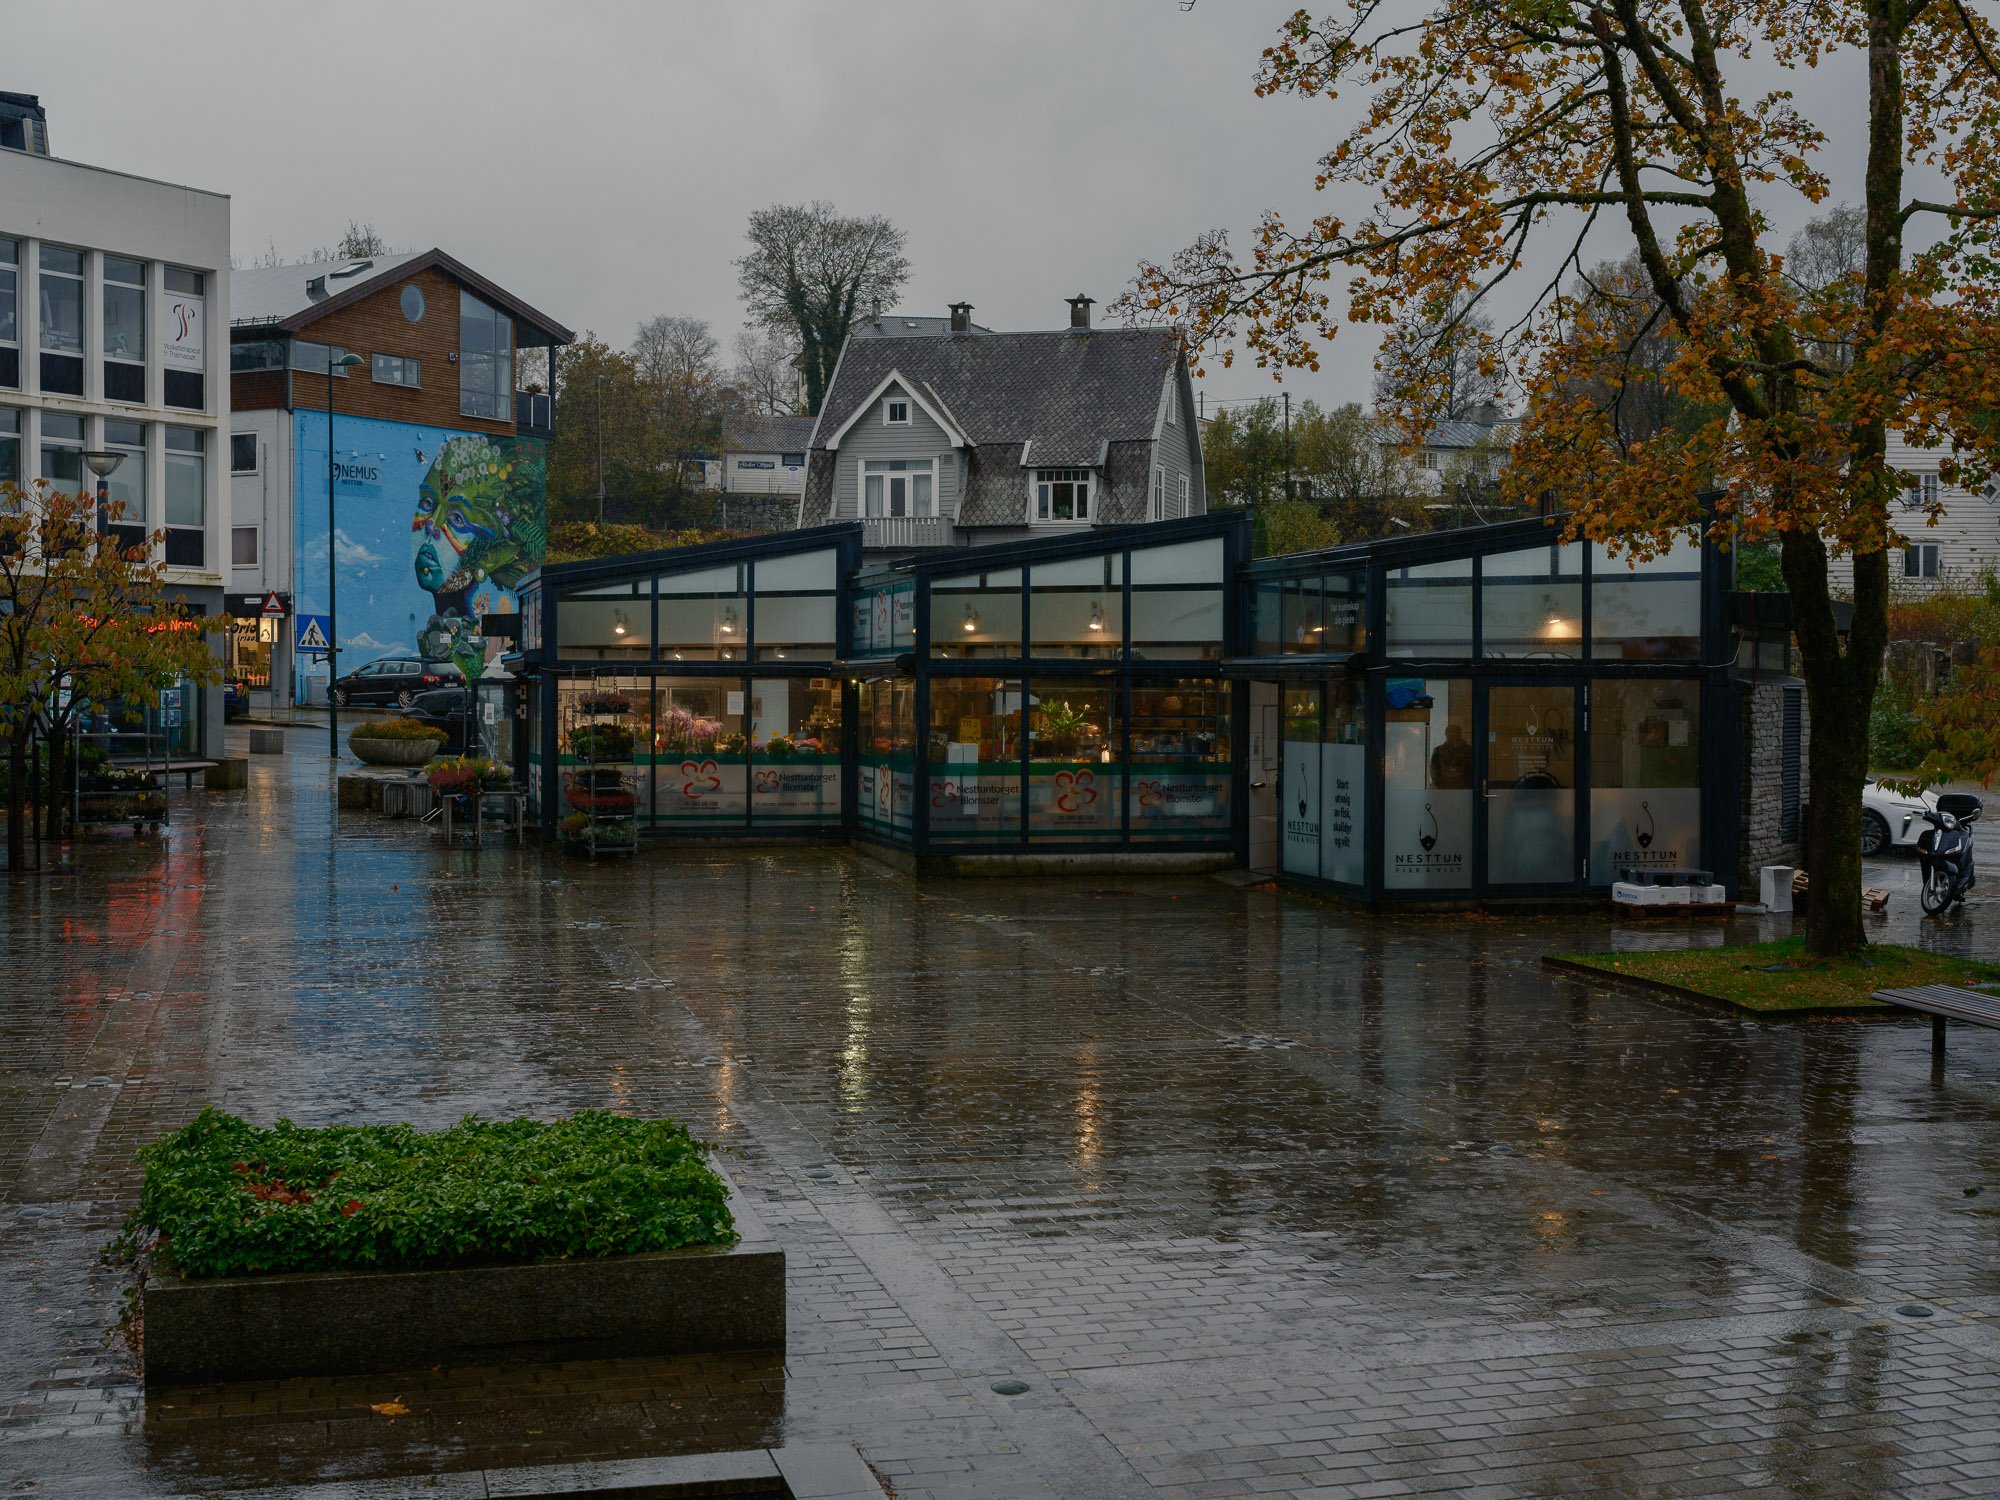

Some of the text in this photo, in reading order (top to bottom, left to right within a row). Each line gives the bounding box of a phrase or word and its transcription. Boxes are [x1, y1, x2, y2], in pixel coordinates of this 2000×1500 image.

[1512, 736, 1554, 744] NESTTUN
[779, 772, 837, 783] Nesttuntorget
[782, 783, 818, 792] Blomster
[1162, 783, 1224, 794] Nesttuntorget
[1336, 778, 1350, 790] Stort
[956, 784, 1020, 795] Nesttuntorget
[960, 796, 1000, 805] Blomster
[1166, 794, 1204, 804] Blomster
[1335, 793, 1351, 806] utvalg
[1334, 809, 1340, 817] av
[1288, 820, 1319, 832] NESTTUN
[1333, 820, 1352, 836] skalldyr
[1288, 834, 1299, 842] FISK
[1306, 837, 1319, 845] VILT
[1334, 838, 1341, 848] og
[1396, 854, 1462, 863] NESTTUN
[1614, 850, 1677, 860] NESTTUN
